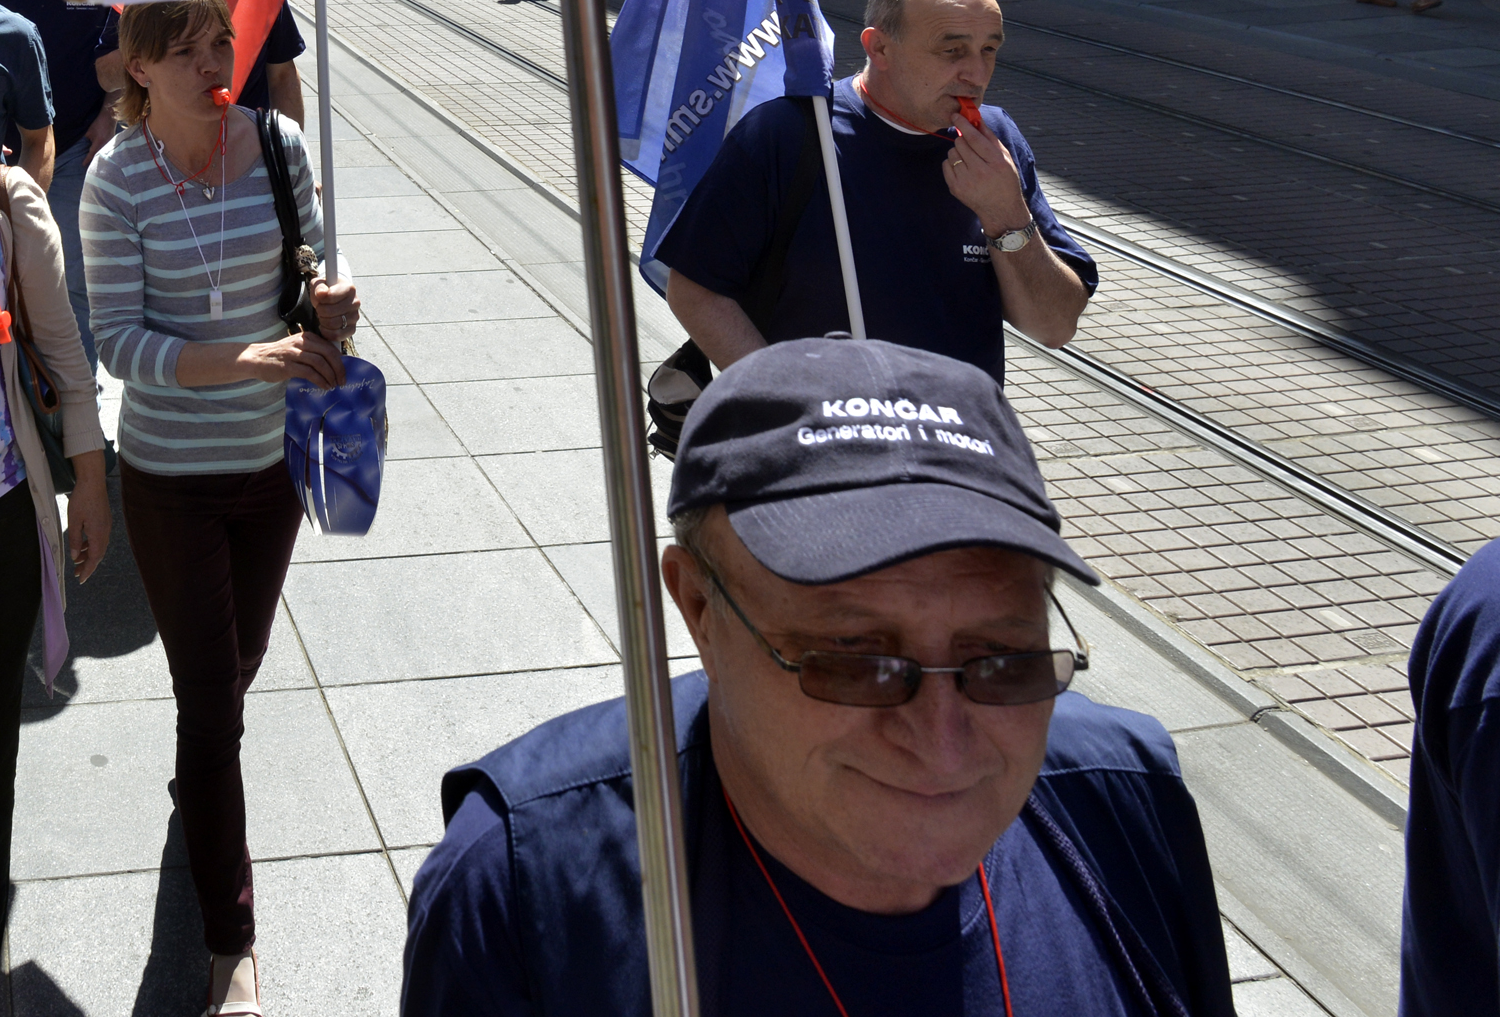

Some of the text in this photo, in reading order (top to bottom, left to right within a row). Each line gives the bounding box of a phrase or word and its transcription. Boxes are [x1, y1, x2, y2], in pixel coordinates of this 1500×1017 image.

[822, 397, 964, 425] KONČAR
[798, 424, 995, 456] Generatori i motori
